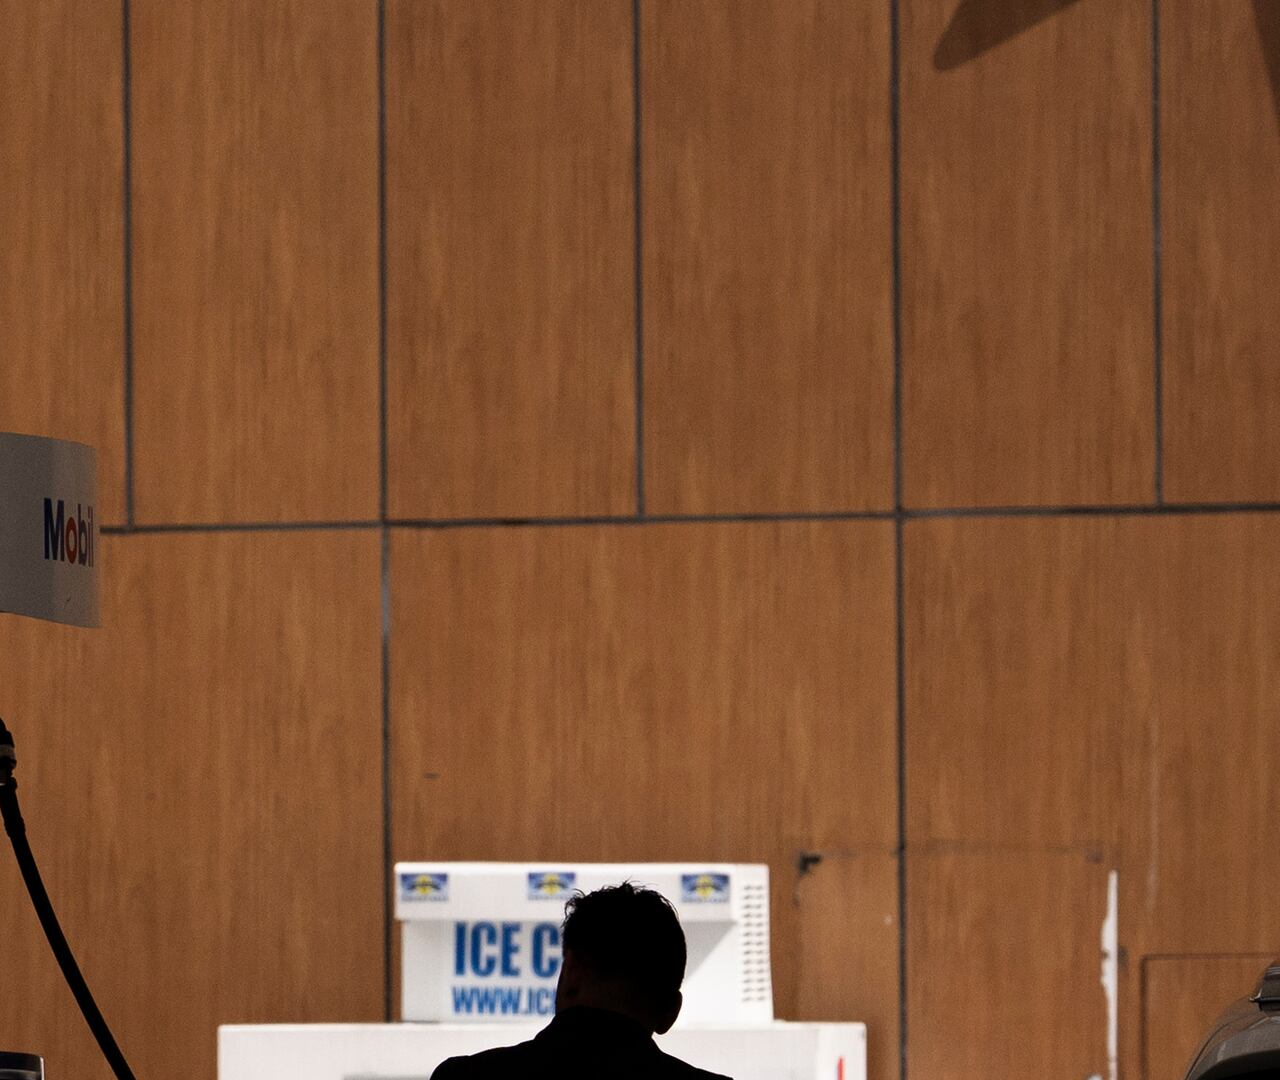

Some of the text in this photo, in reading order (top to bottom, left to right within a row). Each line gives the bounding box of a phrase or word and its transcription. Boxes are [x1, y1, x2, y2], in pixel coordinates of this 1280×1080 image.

[44, 497, 94, 568] Mobil
[455, 921, 521, 977] ICE
[452, 986, 557, 1016] WWW.IC
